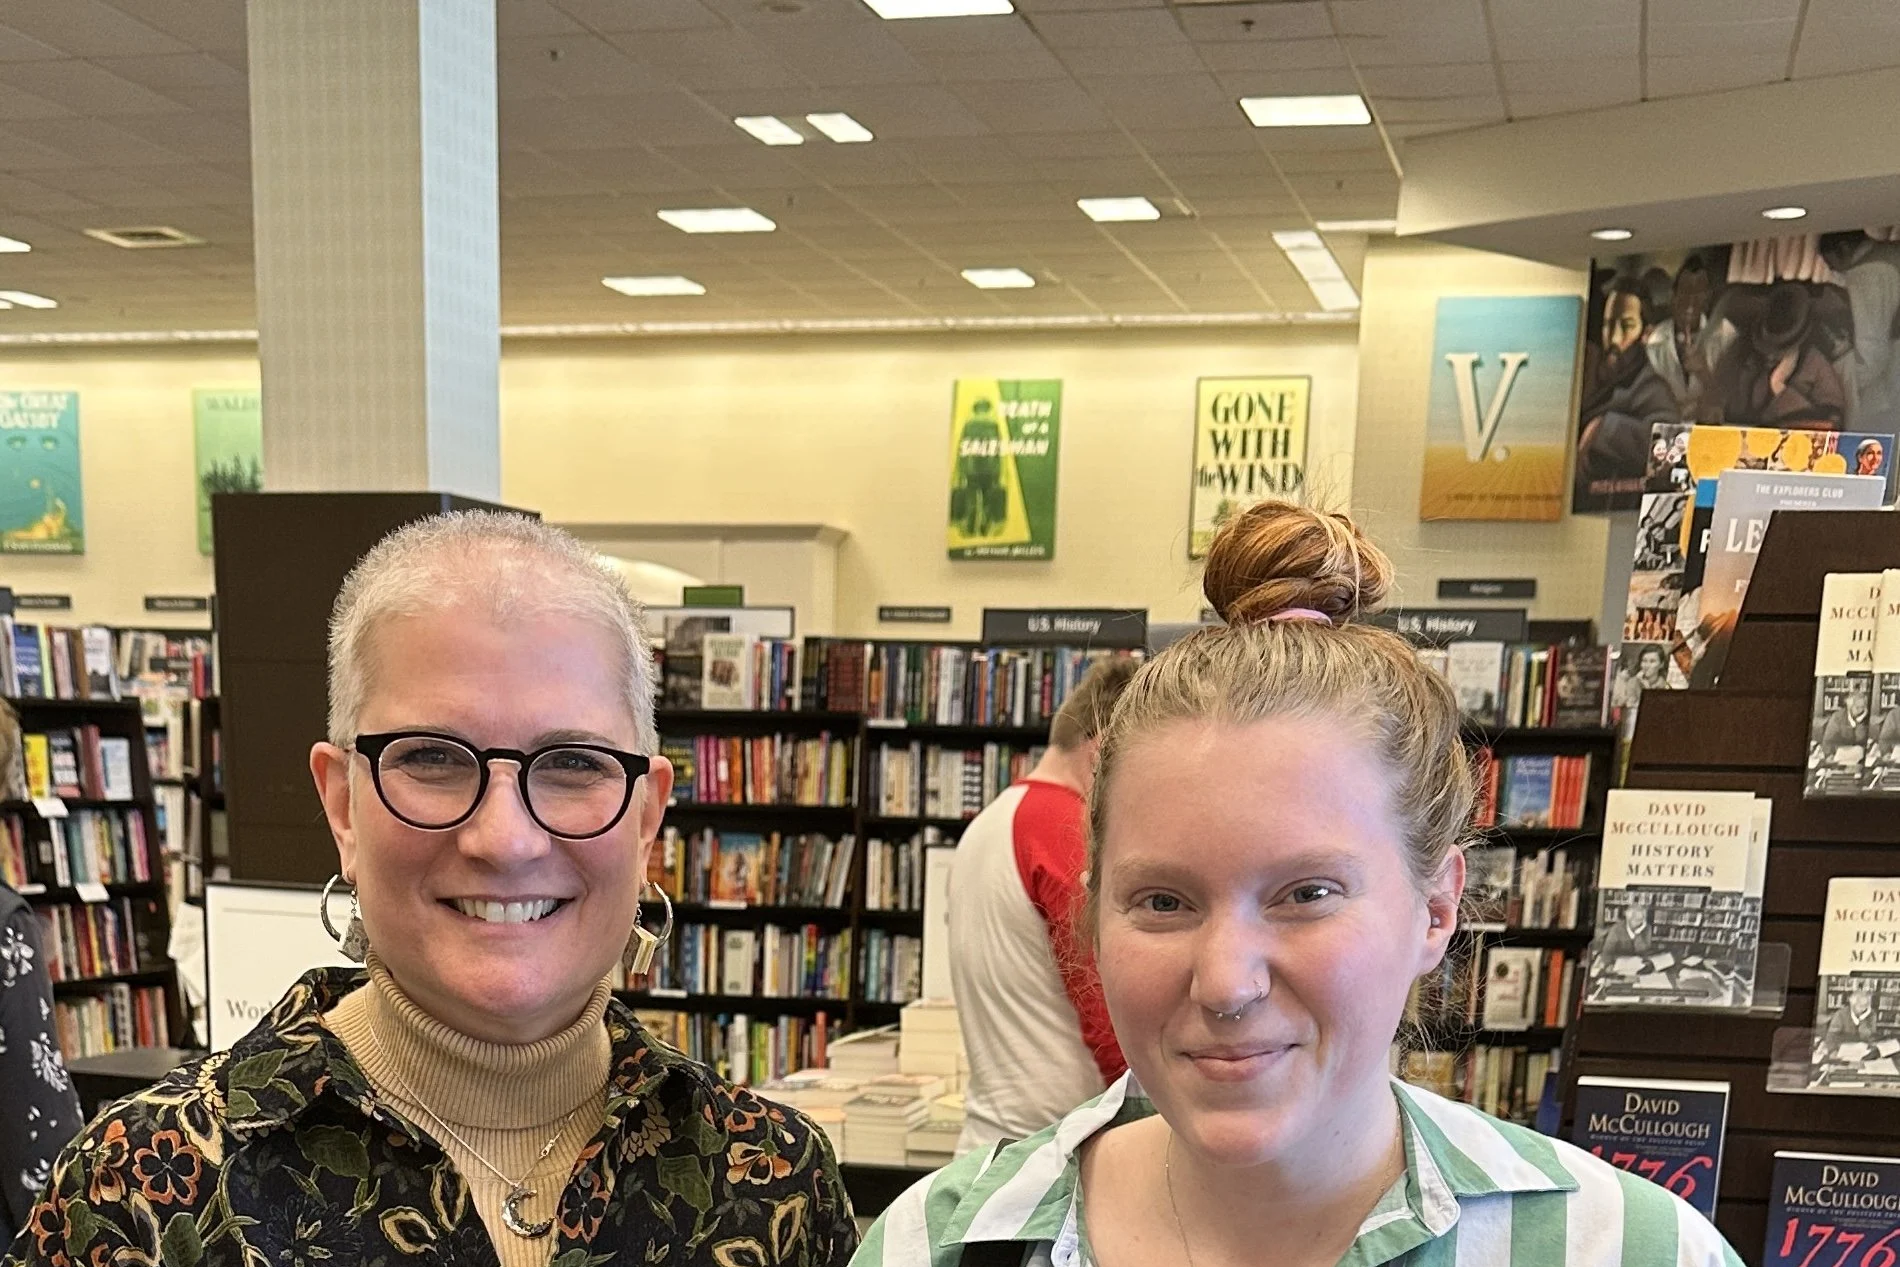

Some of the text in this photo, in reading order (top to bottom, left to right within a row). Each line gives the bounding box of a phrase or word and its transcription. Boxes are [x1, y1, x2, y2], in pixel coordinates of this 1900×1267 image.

[1211, 391, 1296, 424] GONE
[1445, 351, 1530, 463] V.
[1208, 428, 1290, 458] WITH
[1217, 463, 1304, 495] WIND
[1755, 484, 1844, 499] THE EXPLORERS CLUB
[1053, 616, 1101, 635] History
[1425, 616, 1477, 635] History
[1648, 803, 1706, 817] DAVID
[1611, 821, 1740, 838] McCULLOUGH
[1631, 844, 1714, 859] HISTORY
[1626, 864, 1716, 878] MATTERS
[1624, 1092, 1681, 1116] DAVID
[1821, 1165, 1879, 1188] DAVID
[1784, 1185, 1900, 1211] McCULLOUG
